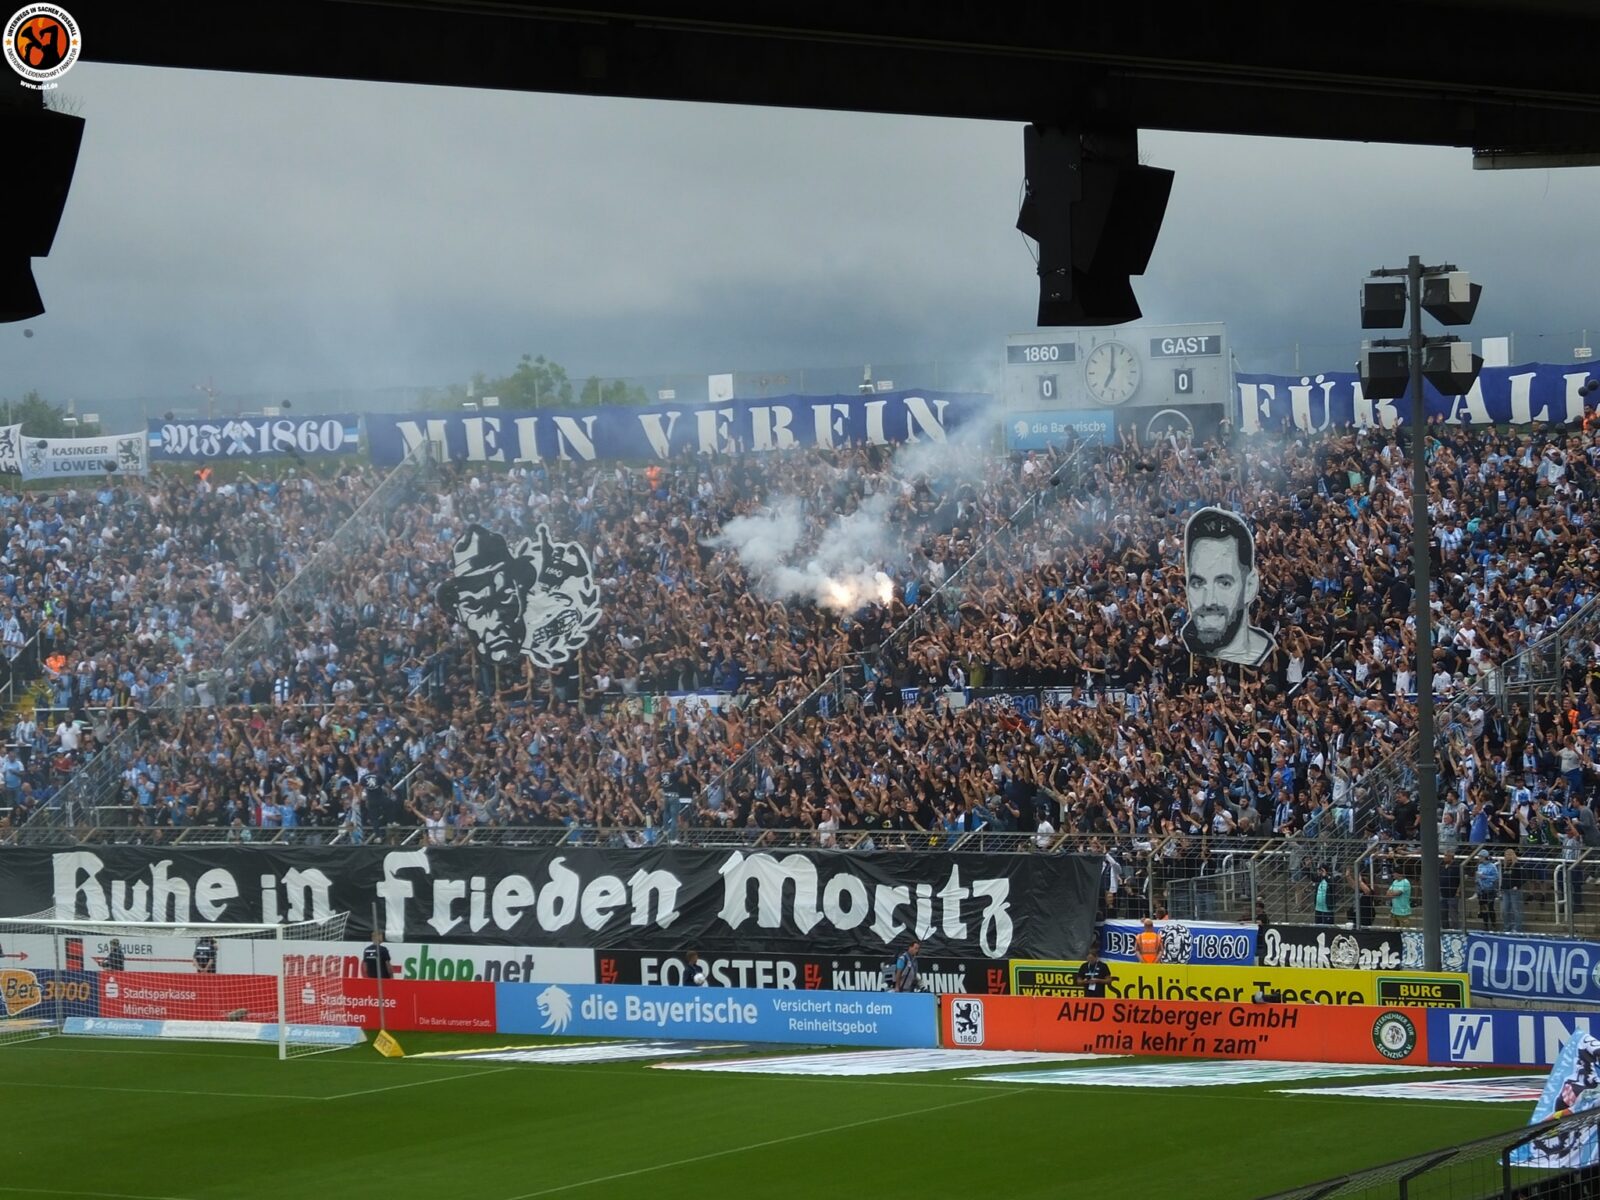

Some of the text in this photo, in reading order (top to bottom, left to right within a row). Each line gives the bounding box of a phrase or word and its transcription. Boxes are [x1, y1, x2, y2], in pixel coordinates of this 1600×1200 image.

[1161, 336, 1209, 354] GAST
[1023, 346, 1059, 362] 1860
[1043, 380, 1052, 397] 0
[1178, 373, 1188, 391] 0
[256, 420, 345, 453] 1860
[396, 396, 950, 465] MEIN VEREIN
[1032, 423, 1048, 434] die
[52, 444, 108, 457] KASINGER
[52, 851, 240, 924] Ruhe
[260, 866, 337, 926] in
[717, 849, 1014, 960] Moritz
[1194, 934, 1251, 961] 1860
[1468, 940, 1590, 995] AUBING
[1035, 972, 1075, 985] BURG
[123, 987, 197, 1001] Stadtsparkasse
[1399, 984, 1442, 998] BURG
[123, 1003, 168, 1016] München
[320, 993, 397, 1009] Stadtsparkasse
[773, 999, 893, 1016] Versichert nach dem
[320, 1011, 366, 1024] München
[581, 994, 758, 1027] die Bayerische
[1057, 1001, 1299, 1031] AHD Sitzberger GmbH
[419, 1016, 492, 1028] Die Bank unserer Stadt.
[788, 1017, 878, 1035] Reinheitsgebot
[1373, 1012, 1408, 1036] UNTERNEHMER
[959, 1035, 978, 1043] 1860
[1376, 1043, 1404, 1059] SECHZIG
